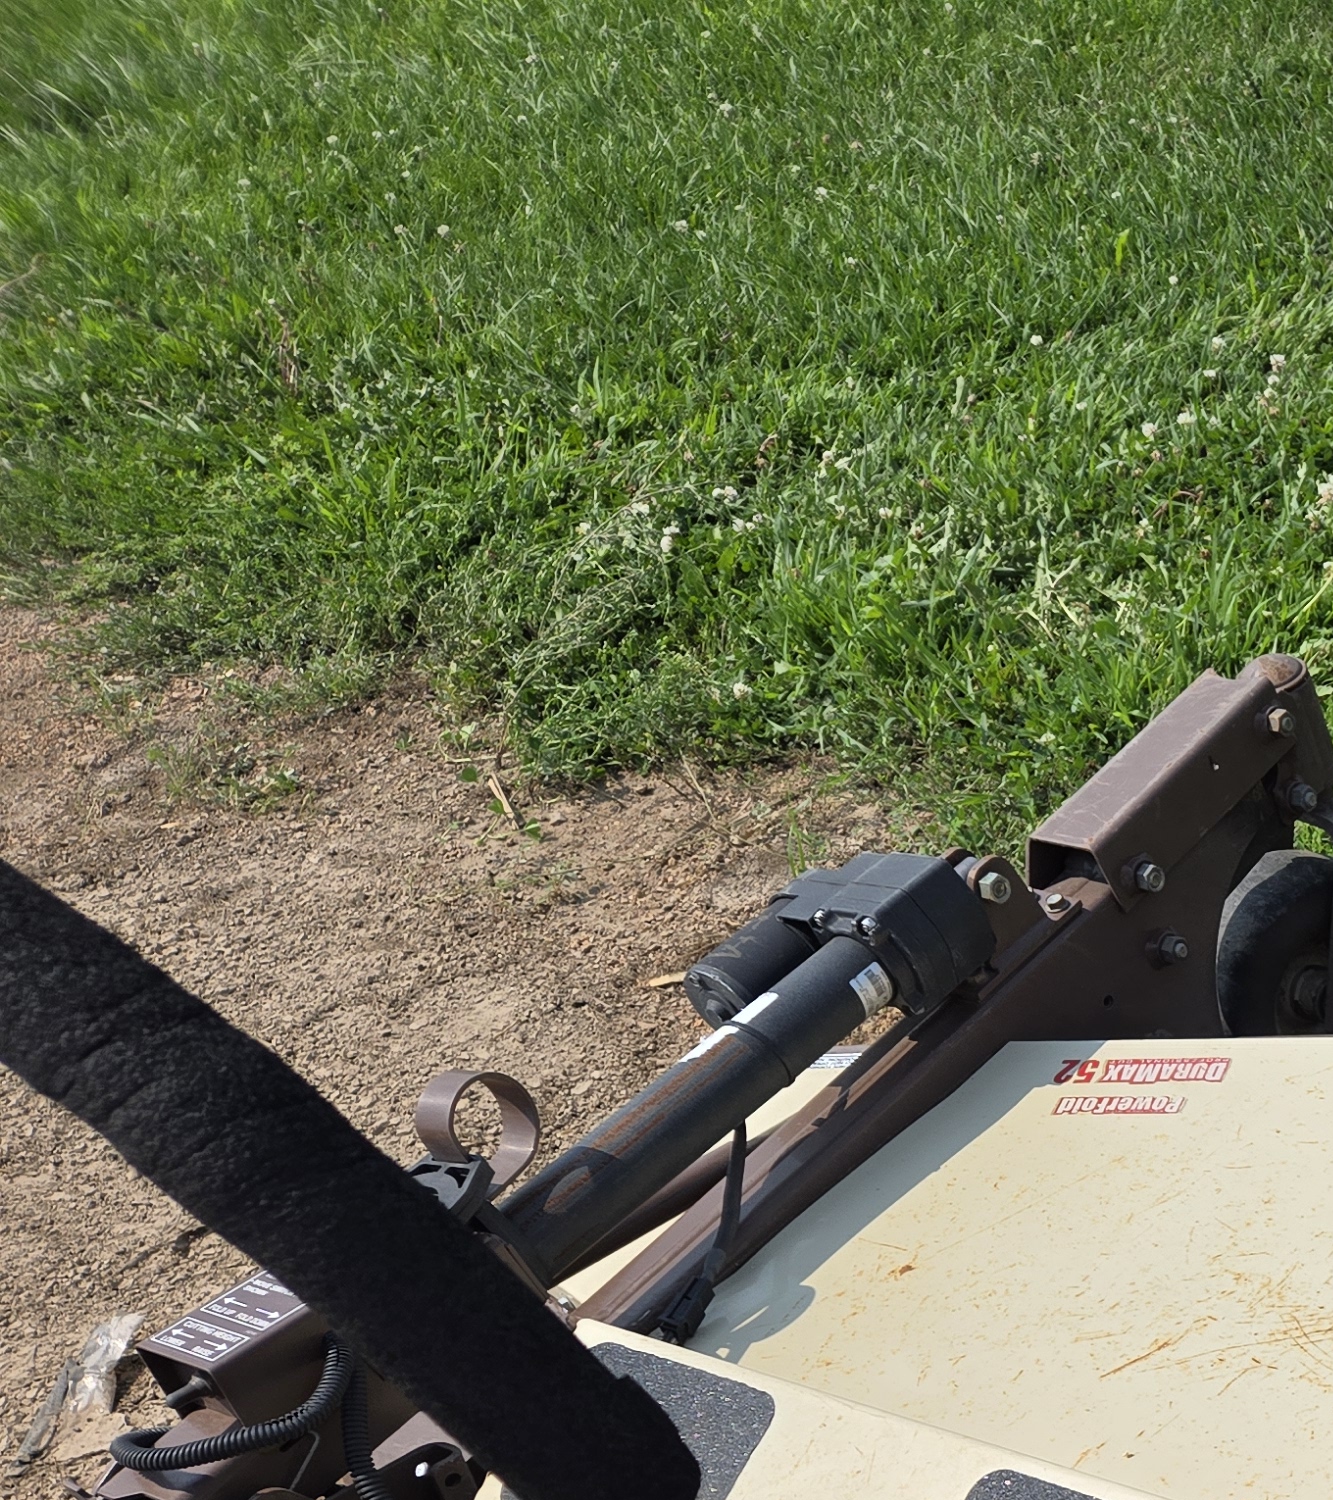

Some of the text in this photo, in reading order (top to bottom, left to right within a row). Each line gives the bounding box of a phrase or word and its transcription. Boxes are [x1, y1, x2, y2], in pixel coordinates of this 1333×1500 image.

[1054, 1060, 1100, 1083] 52
[1058, 1097, 1183, 1113] PowerFold
[180, 1321, 216, 1334] CUTTING
[210, 1330, 242, 1342] HEIGHT
[158, 1335, 187, 1346] LOWER
[189, 1345, 216, 1356] RAISE
